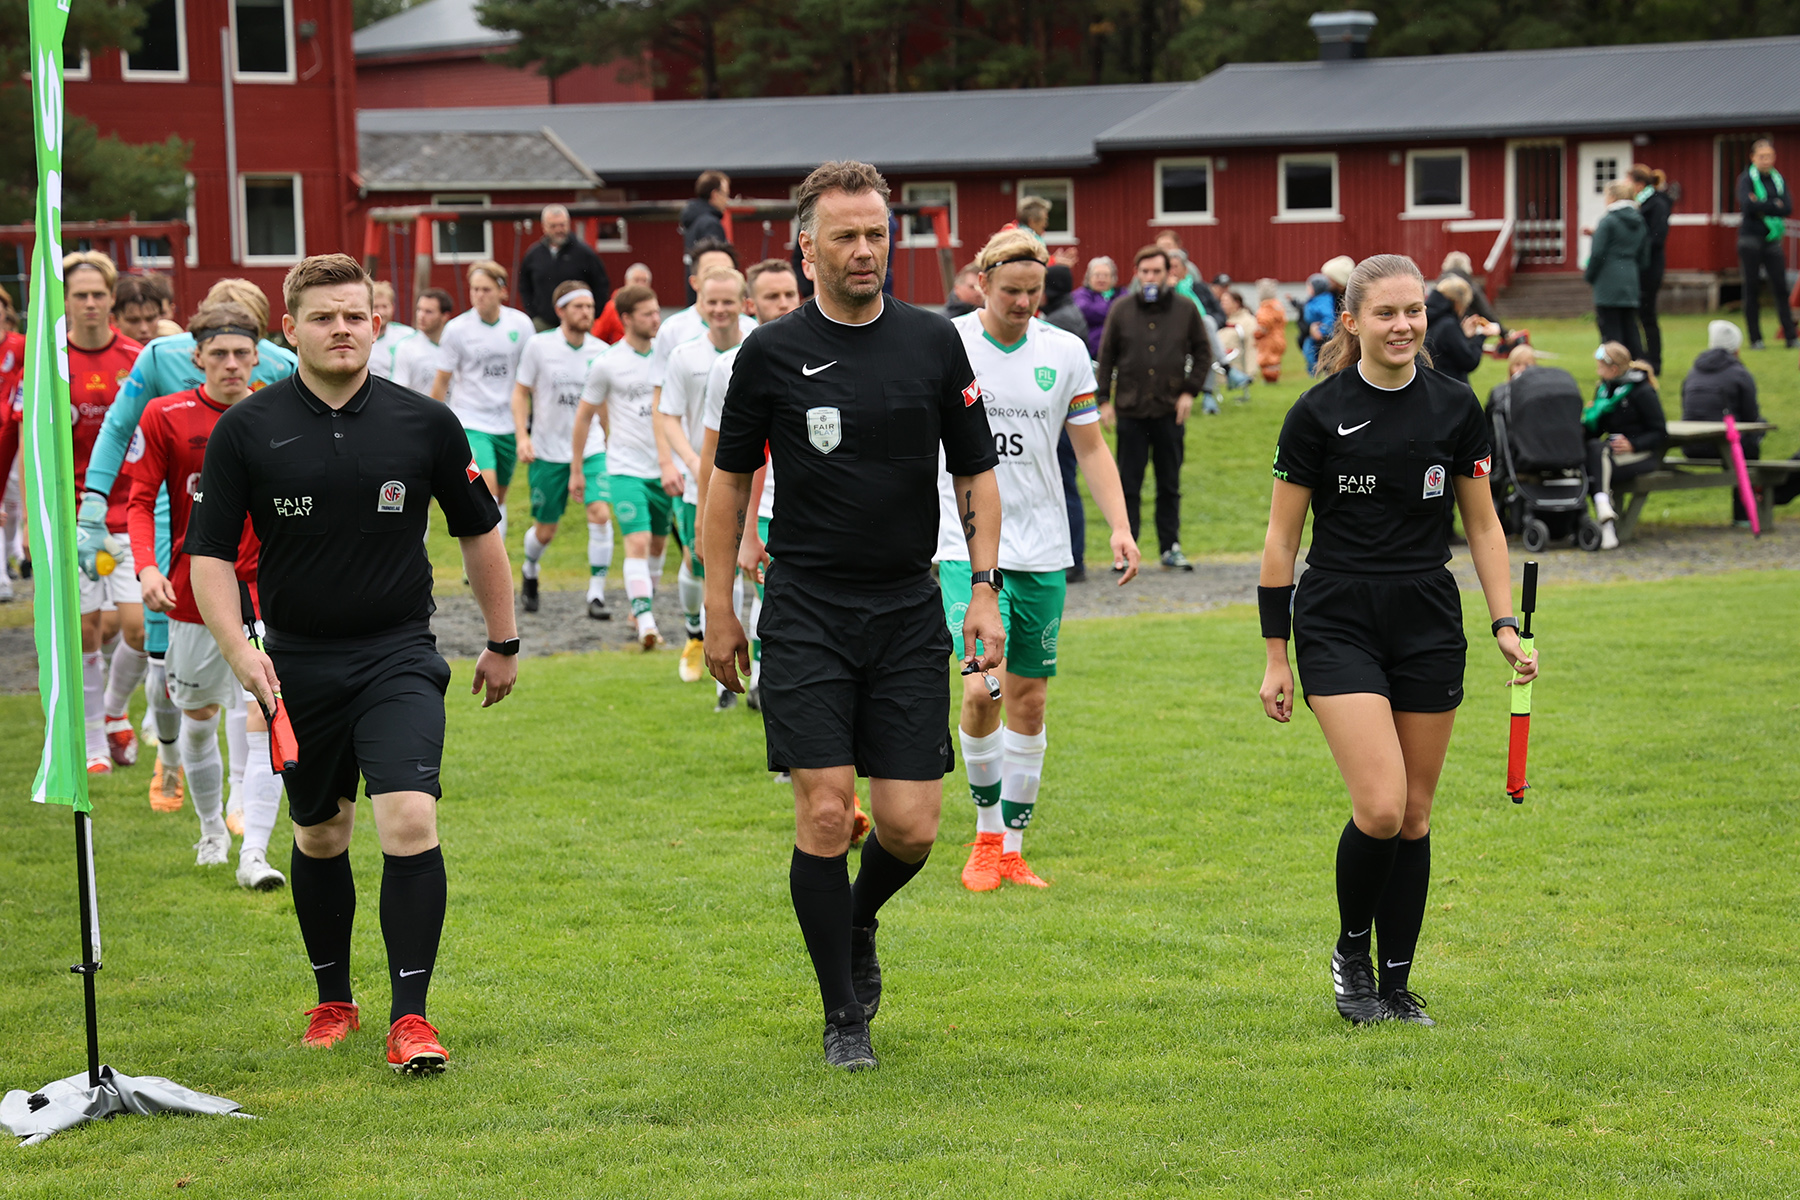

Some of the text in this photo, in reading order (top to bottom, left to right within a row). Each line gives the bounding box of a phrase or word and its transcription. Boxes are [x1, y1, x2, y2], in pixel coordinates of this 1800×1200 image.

[1038, 369, 1053, 380] FIL
[79, 402, 110, 417] Gjen
[1033, 410, 1047, 420] AS
[993, 432, 1024, 457] QS
[1338, 475, 1376, 485] FAIR
[1339, 484, 1376, 494] PLAY
[273, 496, 313, 508] FAIR
[276, 506, 313, 517] PLAY
